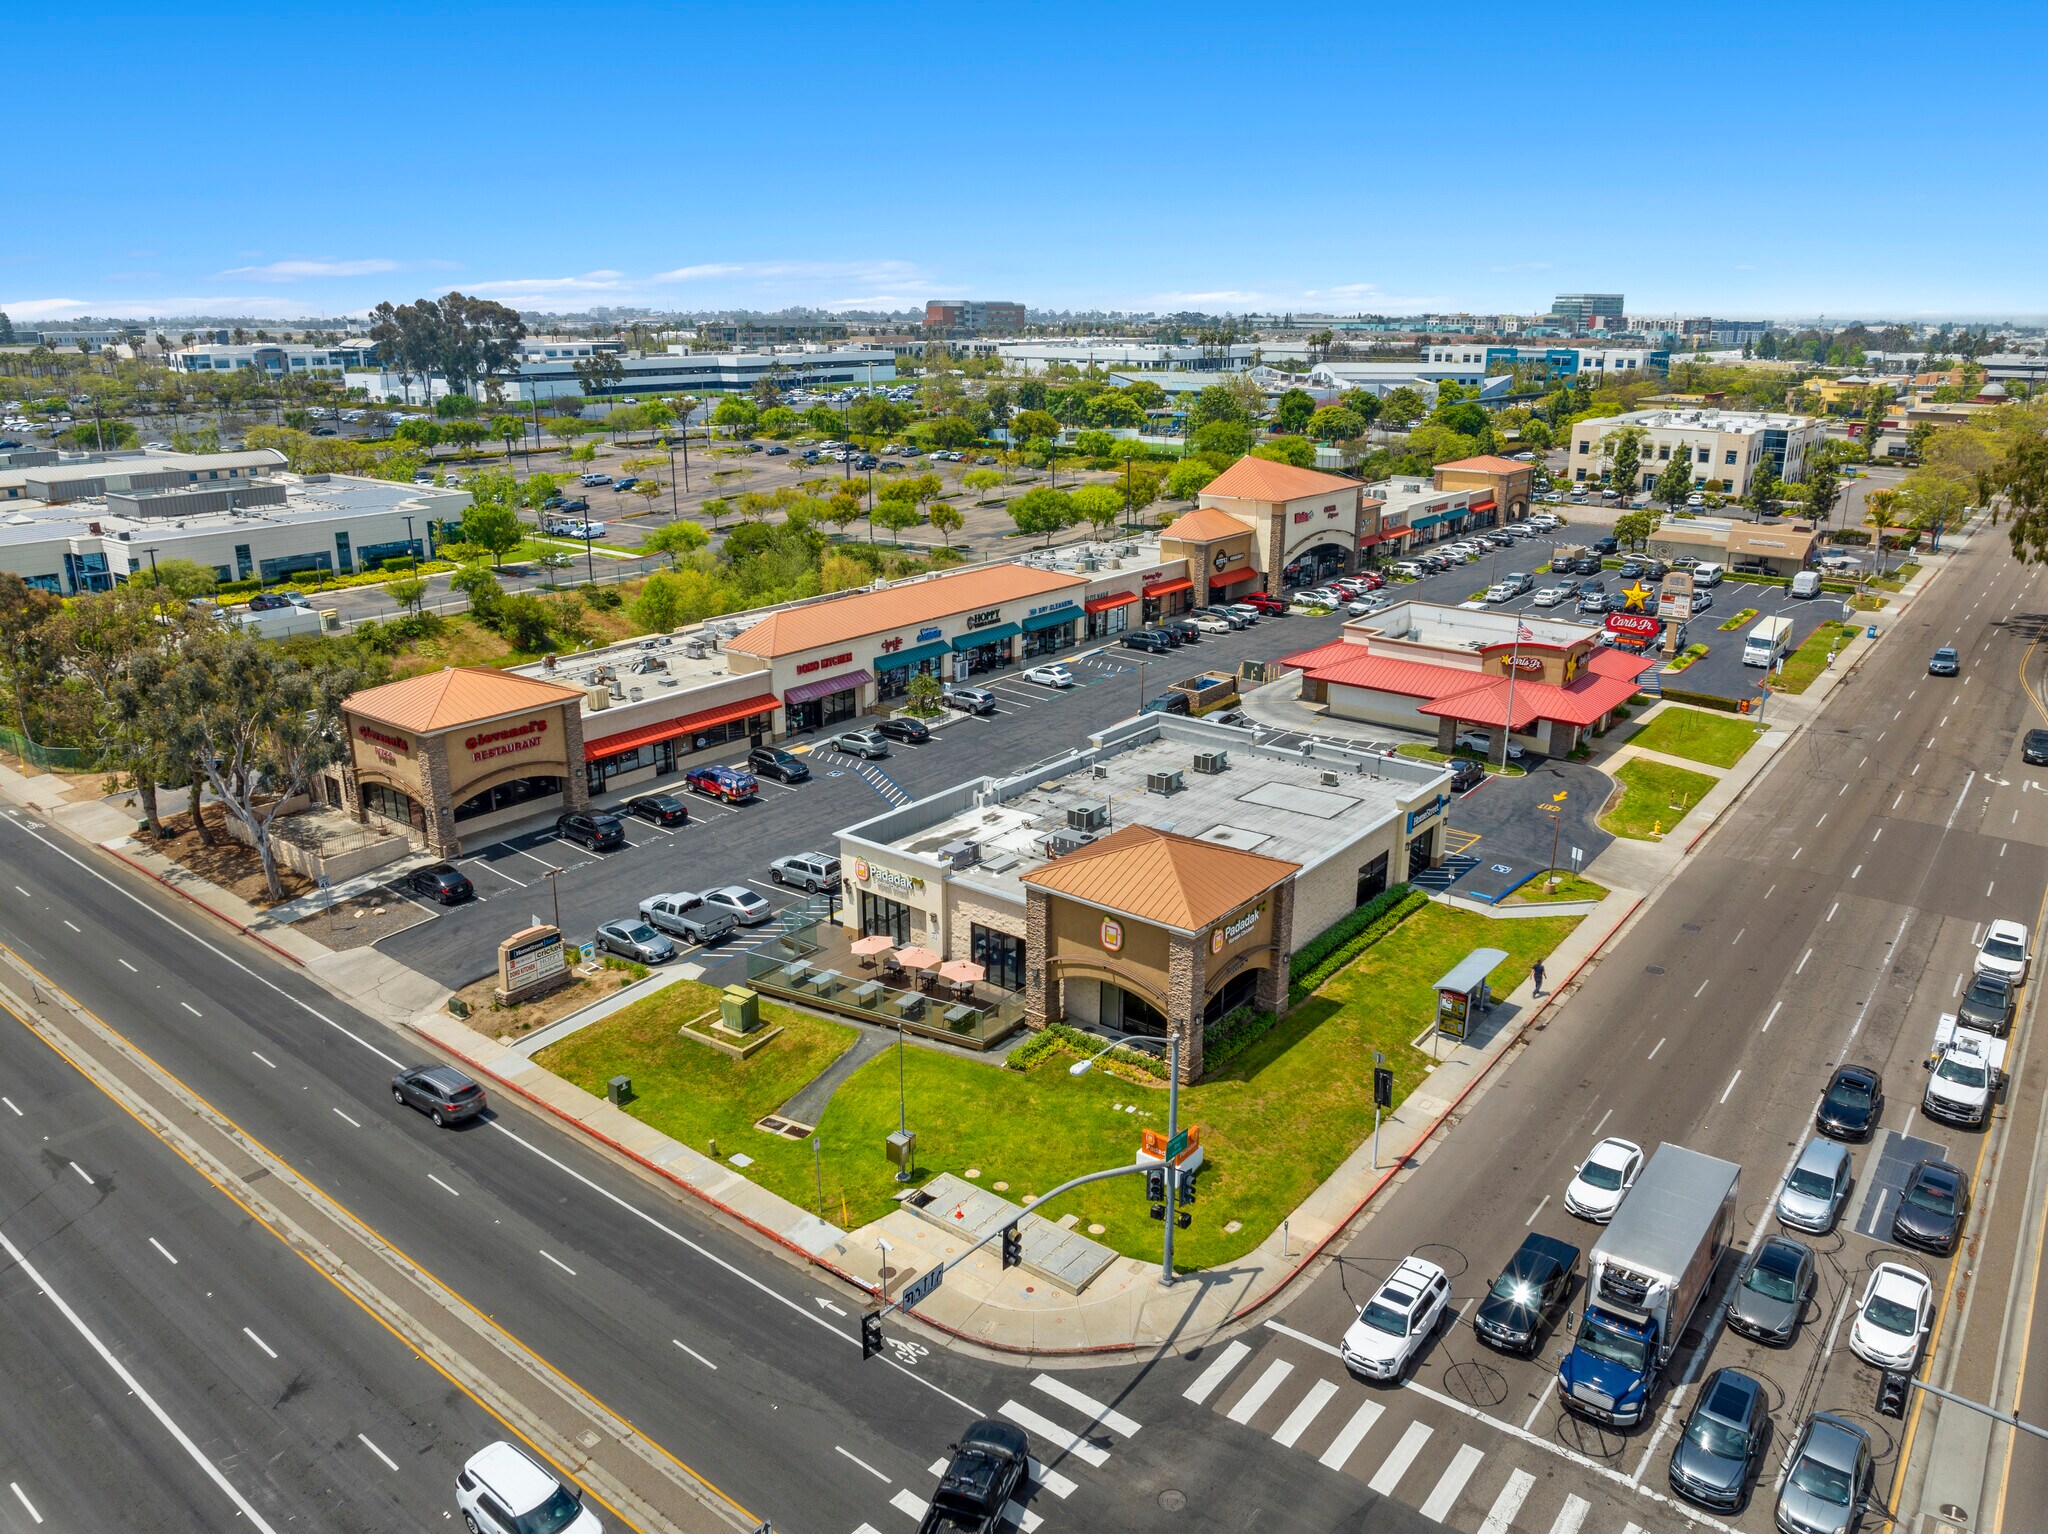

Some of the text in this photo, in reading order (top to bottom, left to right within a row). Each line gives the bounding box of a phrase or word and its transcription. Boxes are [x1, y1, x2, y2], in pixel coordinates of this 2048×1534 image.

[1049, 599, 1074, 611] CLEANERS
[974, 608, 1001, 622] HOPPY
[1610, 615, 1654, 630] Carl's Jr.
[796, 652, 853, 675] DOMO KITCHEN
[358, 725, 408, 752] Giovanni's
[465, 720, 548, 750] Giovanni's
[472, 736, 542, 762] RESTAURANT
[1536, 803, 1562, 812] EXIT
[869, 864, 913, 890] Padadak
[1225, 909, 1260, 940] Padadak
[515, 941, 544, 957] HomeStreet
[536, 943, 562, 958] cricket
[540, 953, 560, 965] HOPPY
[509, 969, 520, 978] DOMO
[520, 963, 536, 974] KITCHEN
